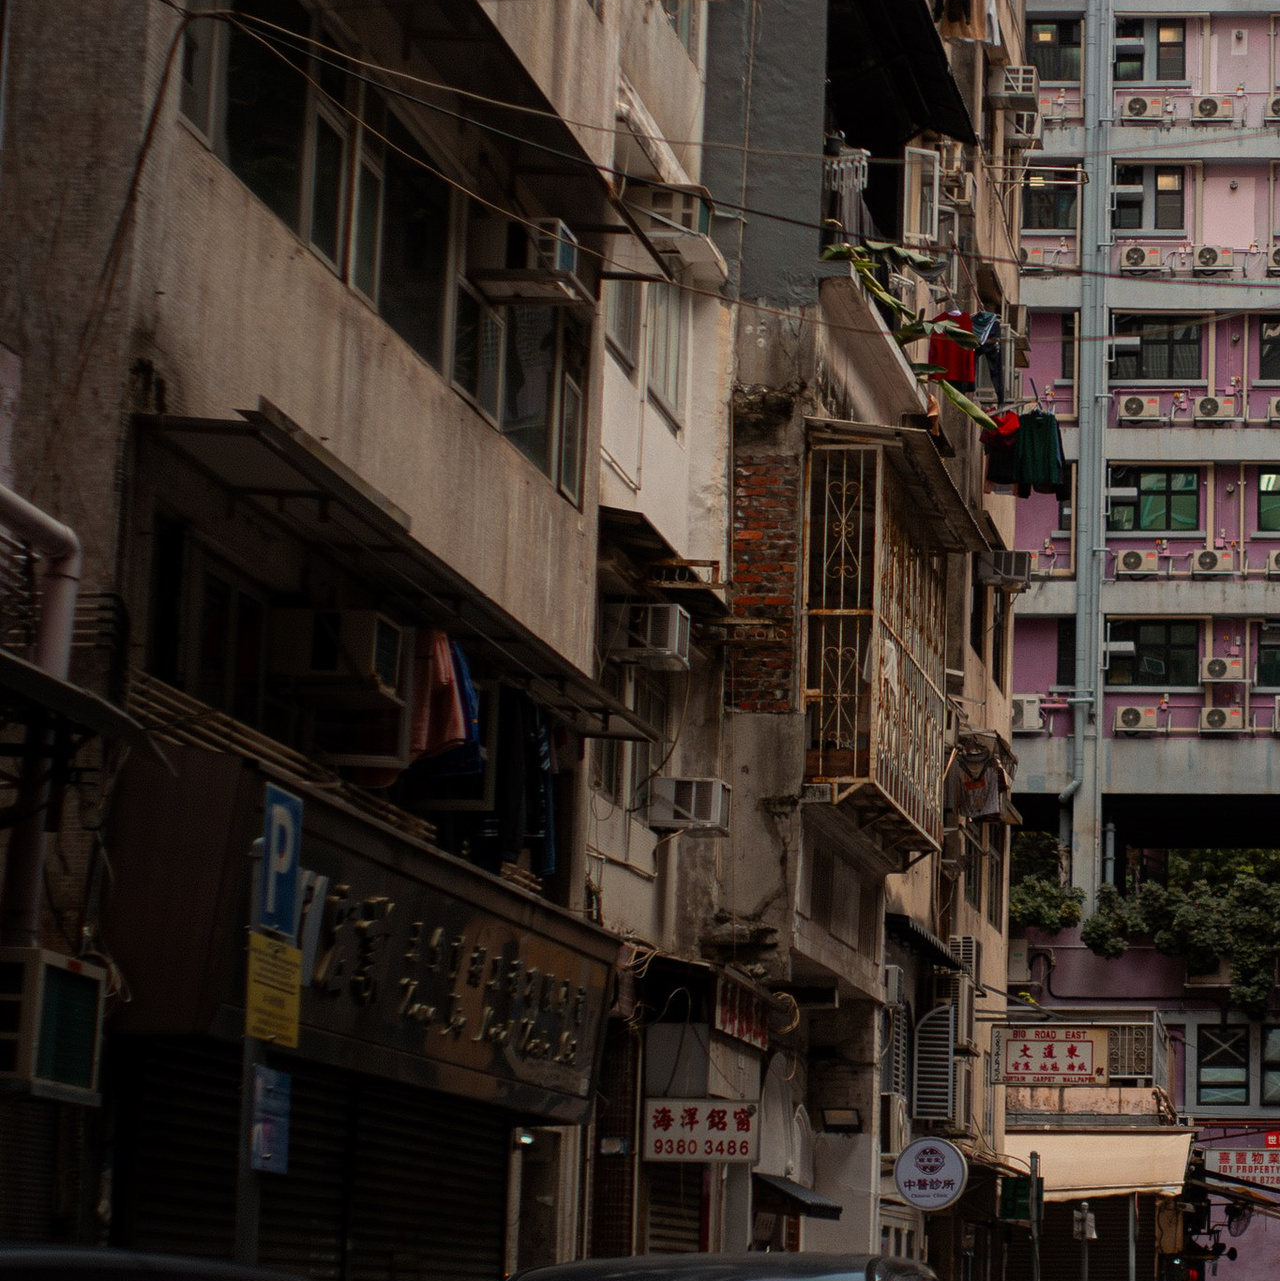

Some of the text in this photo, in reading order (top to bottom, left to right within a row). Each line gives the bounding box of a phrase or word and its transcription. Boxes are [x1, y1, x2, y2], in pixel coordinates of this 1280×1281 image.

[266, 803, 295, 913] P
[1013, 1030, 1087, 1039] BIG ROAD EAST
[1019, 1043, 1080, 1059] 大道東
[652, 1107, 751, 1132] 海洋鋁窗
[654, 1139, 748, 1155] 9380 3486
[1236, 1165, 1280, 1173] PROPERTY
[903, 1178, 955, 1191] 中醫診所
